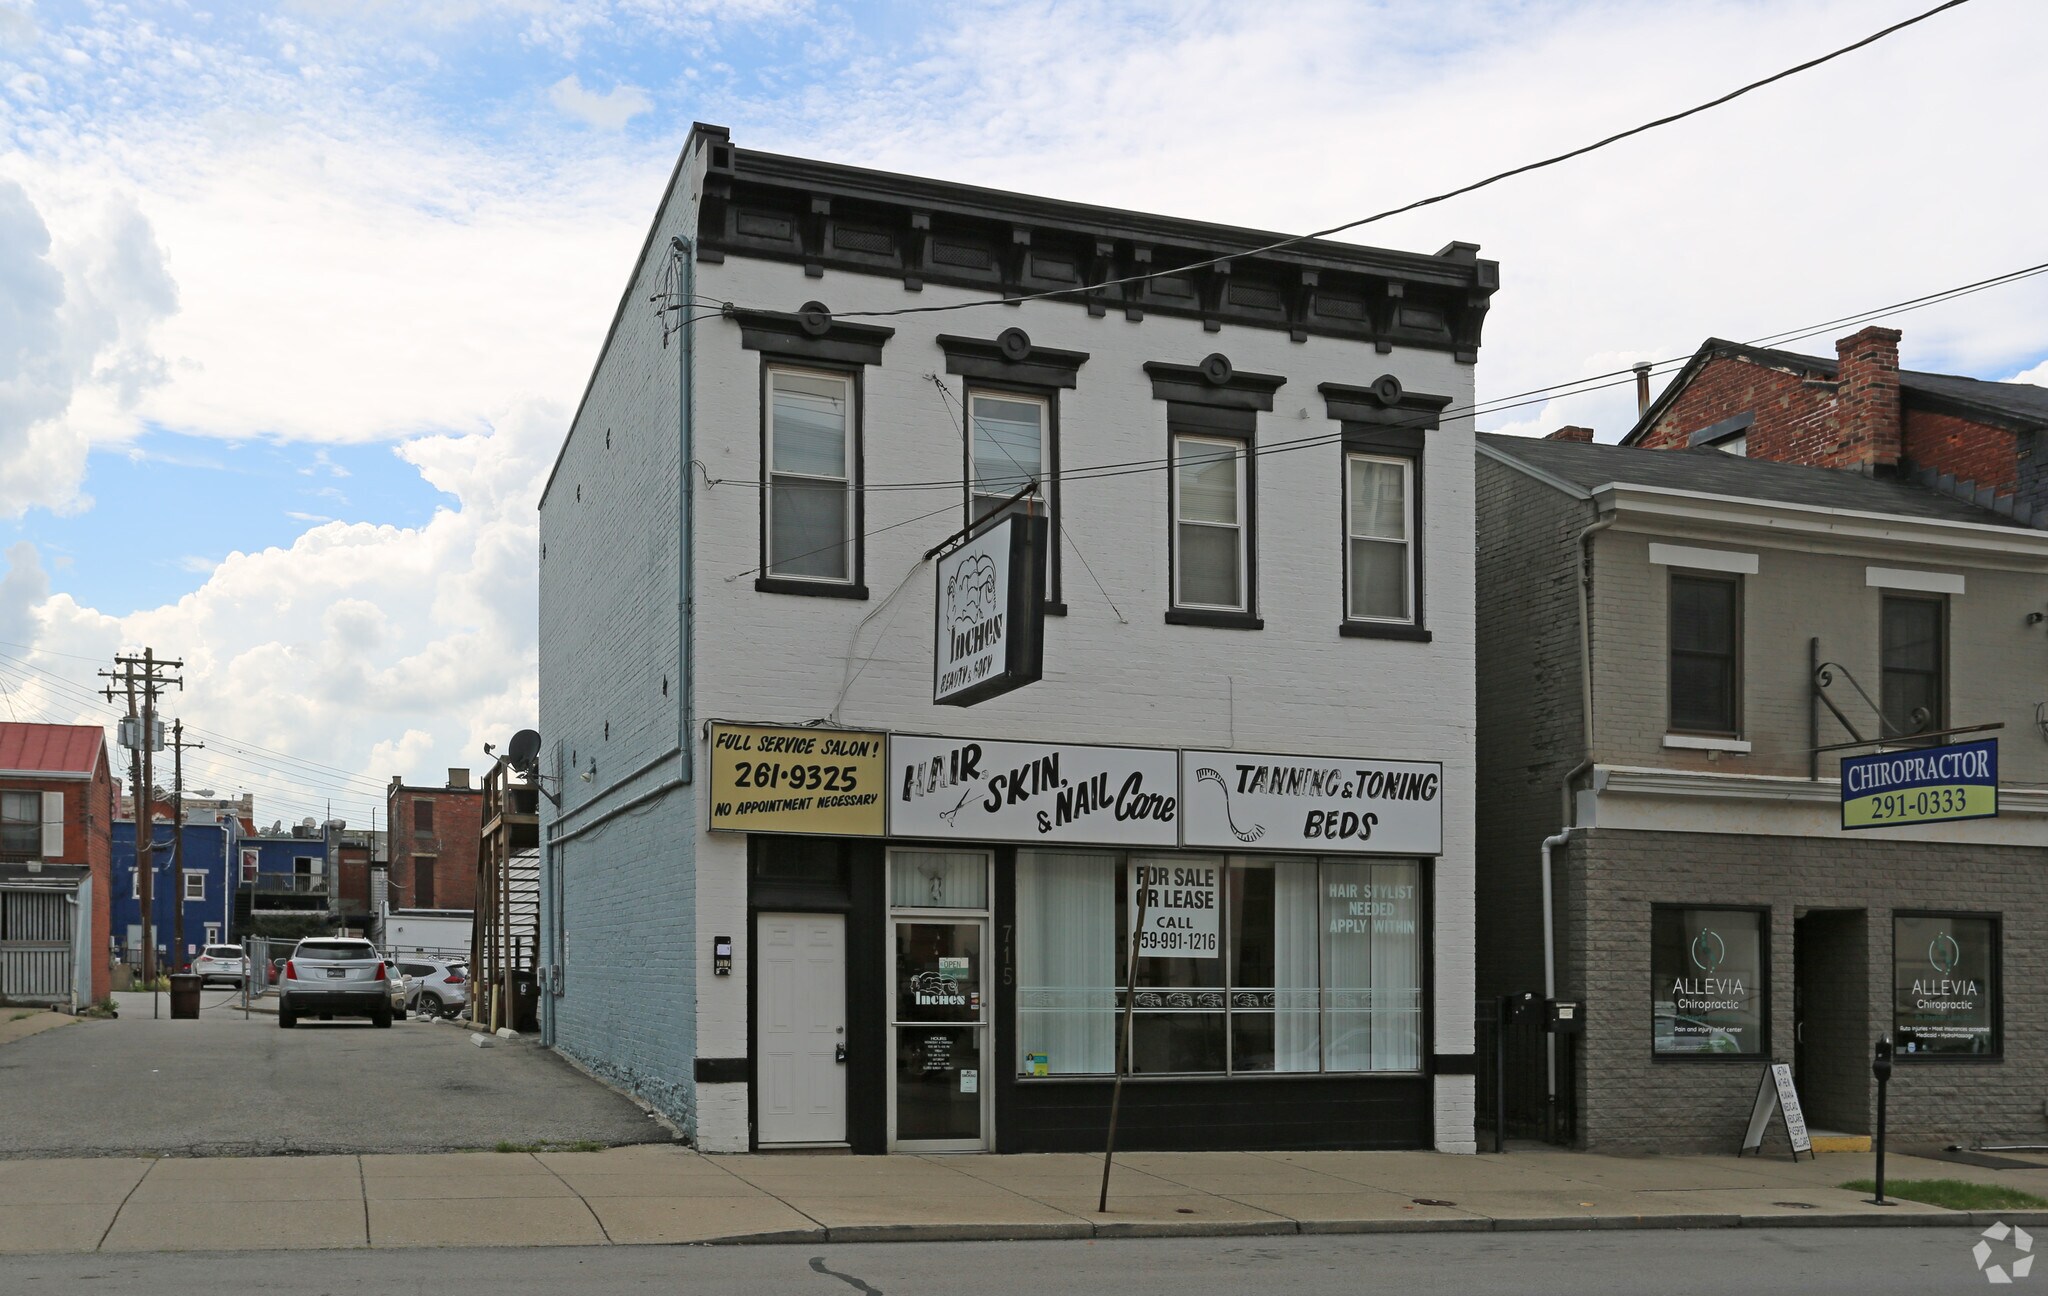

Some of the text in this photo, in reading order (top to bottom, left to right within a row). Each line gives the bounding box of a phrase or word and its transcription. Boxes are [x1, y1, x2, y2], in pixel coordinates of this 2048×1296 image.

[940, 664, 968, 693] BEAUTY
[716, 733, 751, 750] FULL
[758, 736, 816, 754] SERVICE
[1848, 750, 1990, 792] CHIROPRACTOR
[984, 752, 1068, 813] SKIN,
[1341, 781, 1353, 798] &
[1356, 770, 1439, 801] TONING
[715, 793, 878, 817] NO APPOINTMENT NECESSARY
[1036, 771, 1176, 834] & NAIL Care
[1871, 788, 1966, 819] 291-0333
[1303, 810, 1378, 841] BEDS
[1174, 867, 1214, 887] SALE
[1164, 889, 1214, 909] LEASE
[1329, 883, 1413, 899] HAIR STYLIST
[1349, 902, 1395, 916] NEEDED
[1156, 916, 1193, 929] CALL
[1329, 919, 1415, 934] APPLY WITHIN
[1133, 931, 1215, 950] 59-991-1216
[944, 960, 961, 968] OPEN
[1672, 977, 1744, 995] ALLEVIA
[1912, 979, 1977, 996] ALLEVIA
[1678, 998, 1739, 1011] Chiropractic
[1917, 999, 1973, 1011] Chiropractic
[1698, 1026, 1712, 1034] injury
